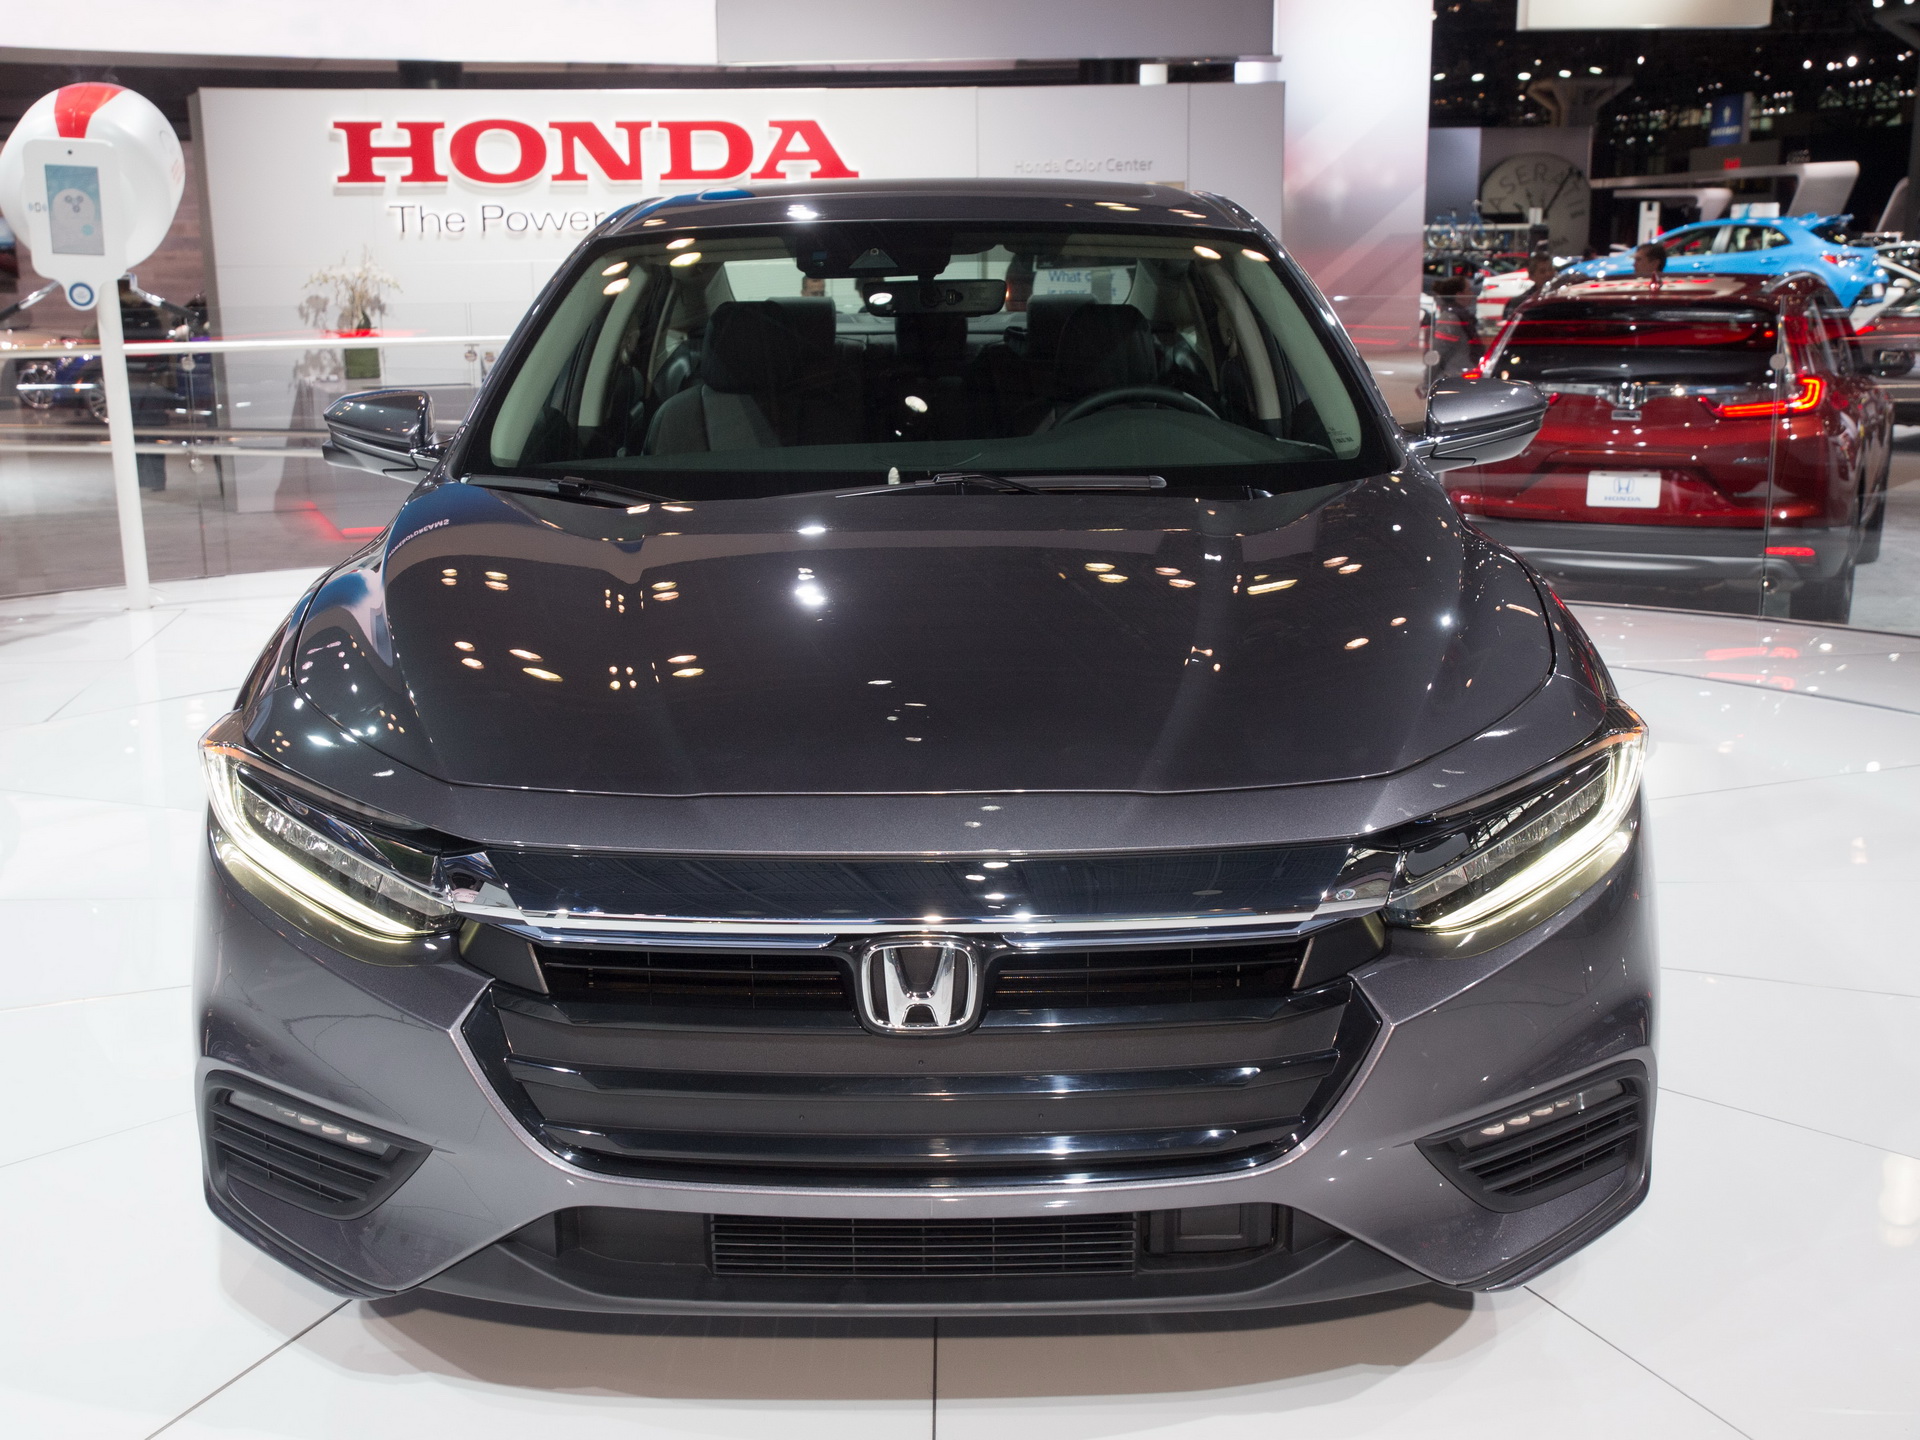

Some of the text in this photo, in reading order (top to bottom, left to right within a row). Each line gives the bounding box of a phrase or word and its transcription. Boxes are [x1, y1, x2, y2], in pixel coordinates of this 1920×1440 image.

[332, 118, 860, 185] HONDA
[1014, 157, 1154, 174] Honda Color Center
[389, 203, 606, 234] The Power
[1048, 270, 1081, 283] What
